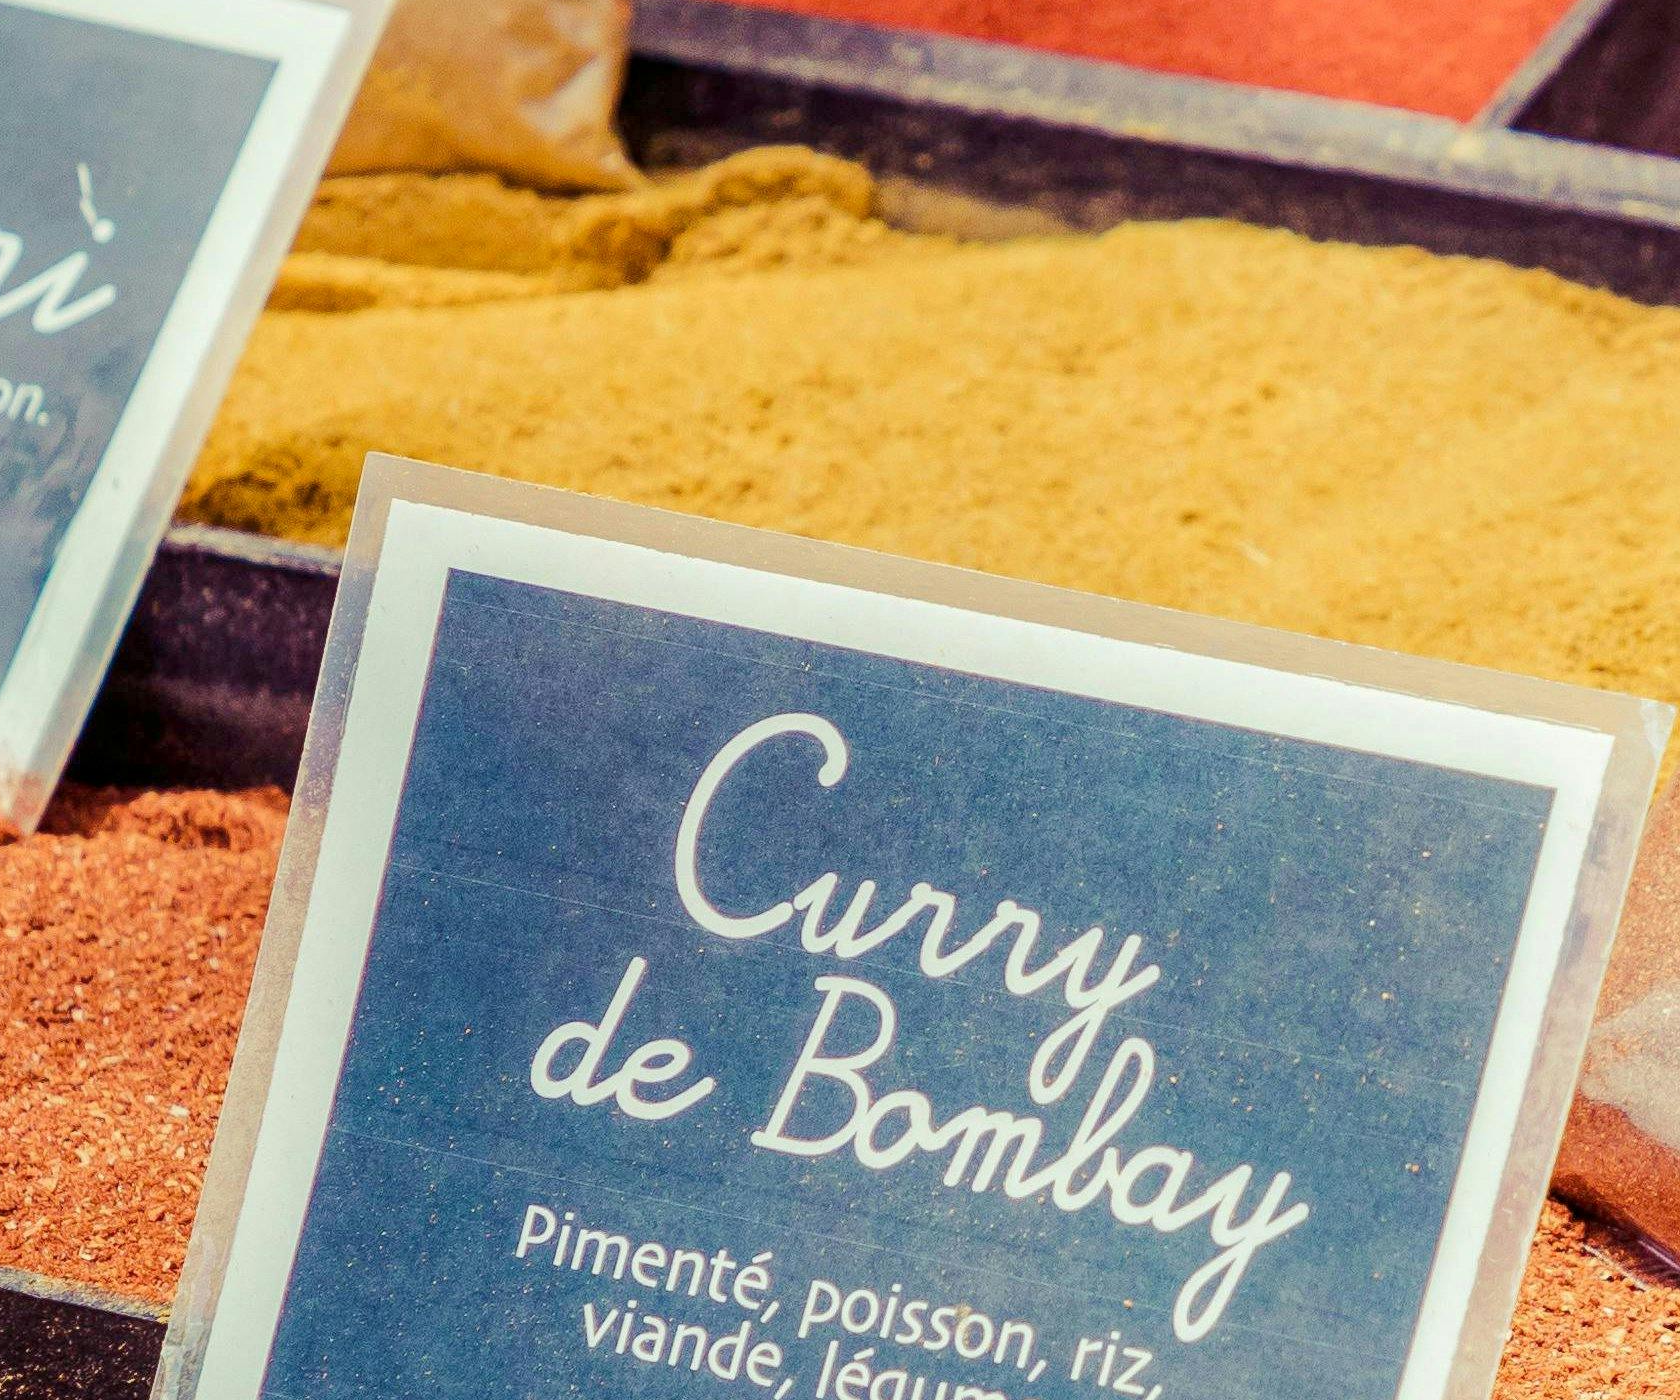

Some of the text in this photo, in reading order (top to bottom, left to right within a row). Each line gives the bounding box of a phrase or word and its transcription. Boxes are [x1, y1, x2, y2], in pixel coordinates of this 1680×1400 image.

[675, 712, 1160, 1105] Curry
[514, 1205, 779, 1323] Pimenté,
[797, 1279, 1047, 1394] poisson,
[528, 956, 1311, 1344] de Bombay
